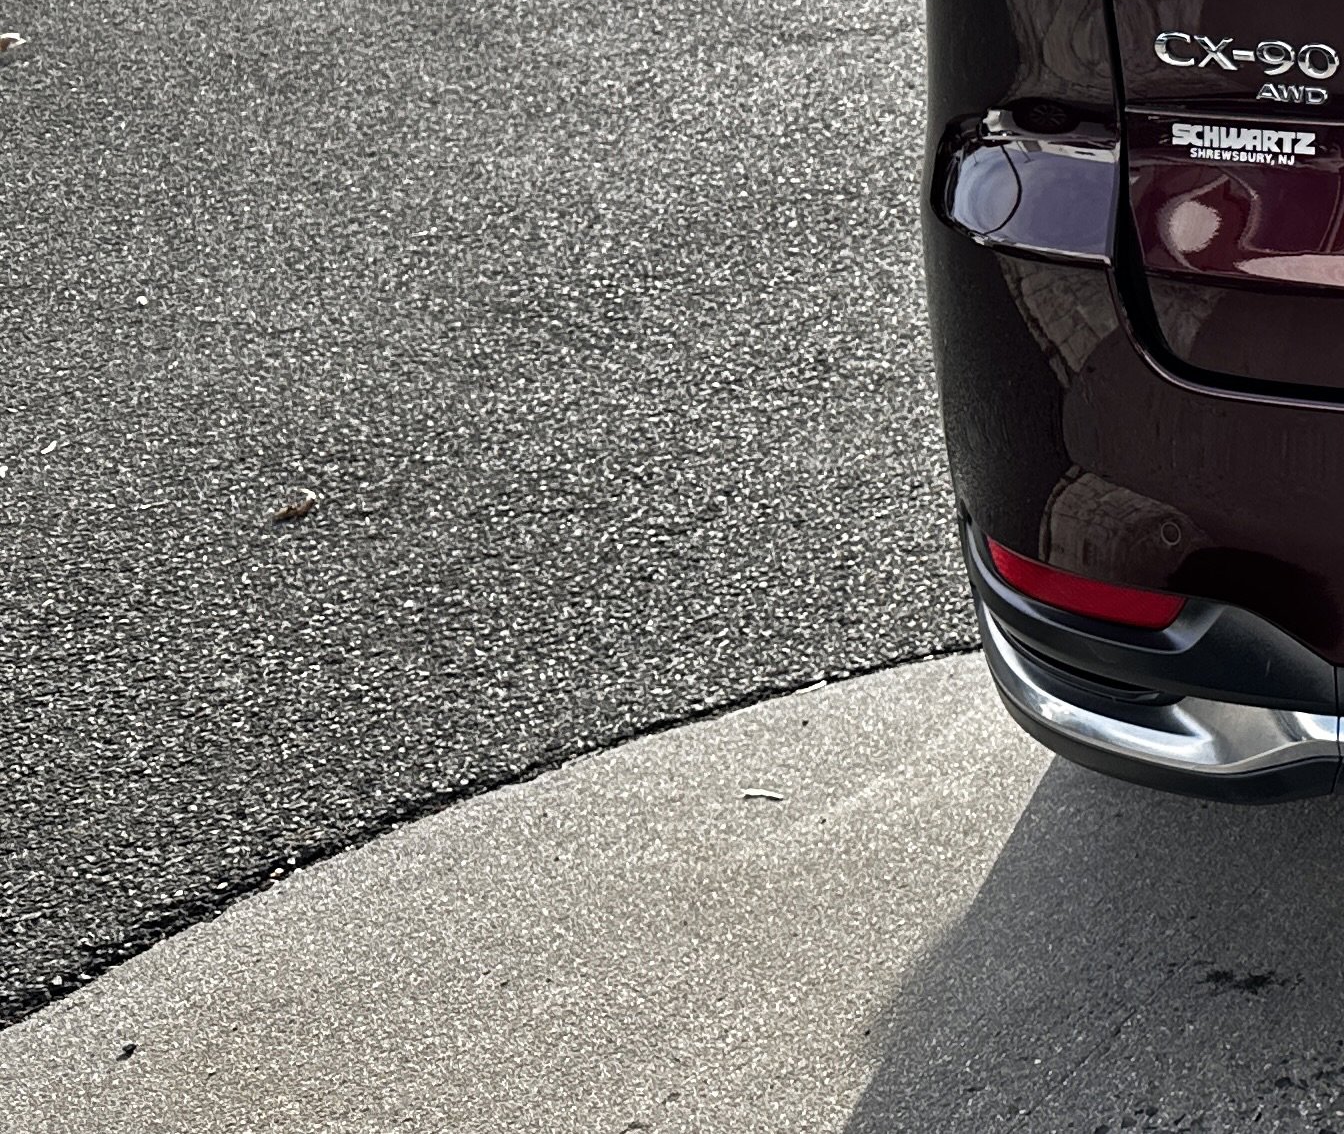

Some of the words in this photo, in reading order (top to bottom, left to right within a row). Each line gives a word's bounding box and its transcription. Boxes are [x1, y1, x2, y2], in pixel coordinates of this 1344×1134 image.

[1154, 31, 1341, 80] CX-90
[1256, 83, 1329, 105] AWD
[1172, 123, 1316, 156] SCHWARTZ
[1190, 147, 1275, 165] SHREWSBURY,
[1278, 155, 1296, 166] NJ
